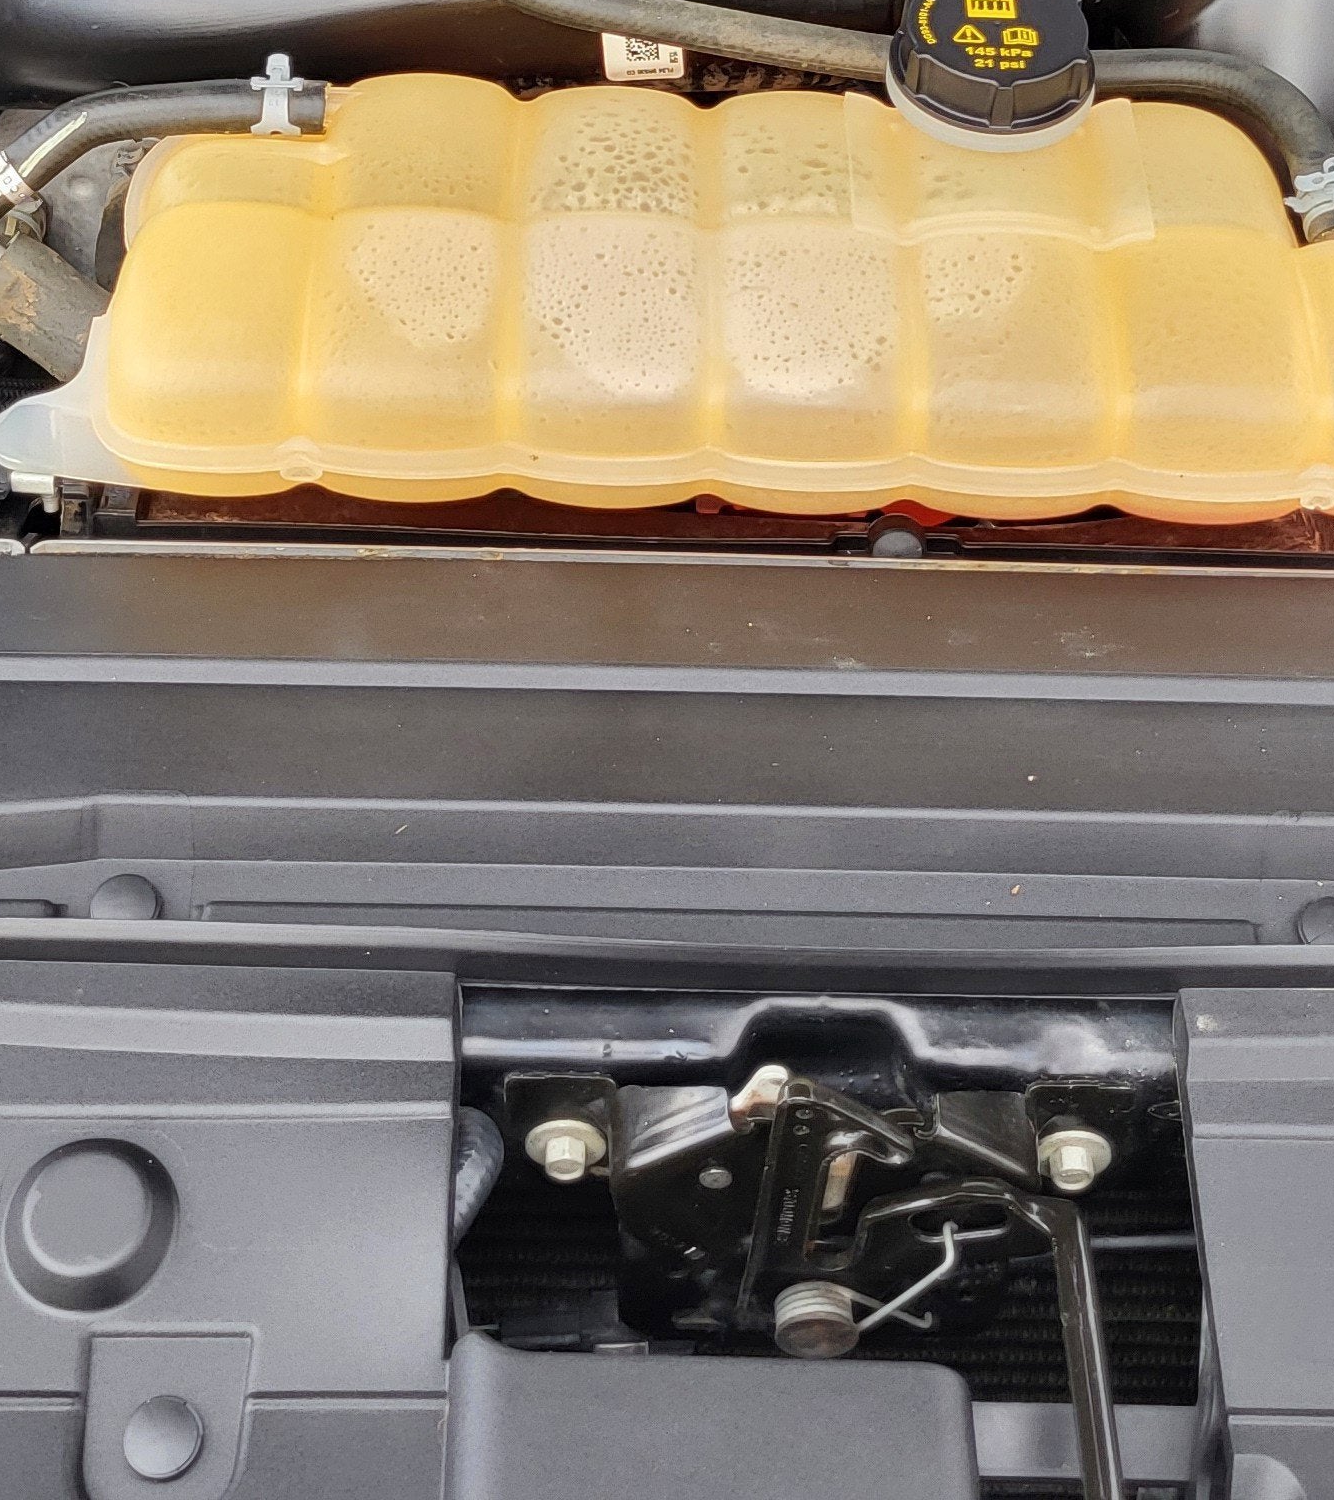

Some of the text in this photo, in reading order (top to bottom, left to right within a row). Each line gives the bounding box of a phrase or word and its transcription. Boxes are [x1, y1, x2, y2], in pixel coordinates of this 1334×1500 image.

[965, 46, 1034, 58] 145 kPa
[973, 58, 1027, 70] 21 psi
